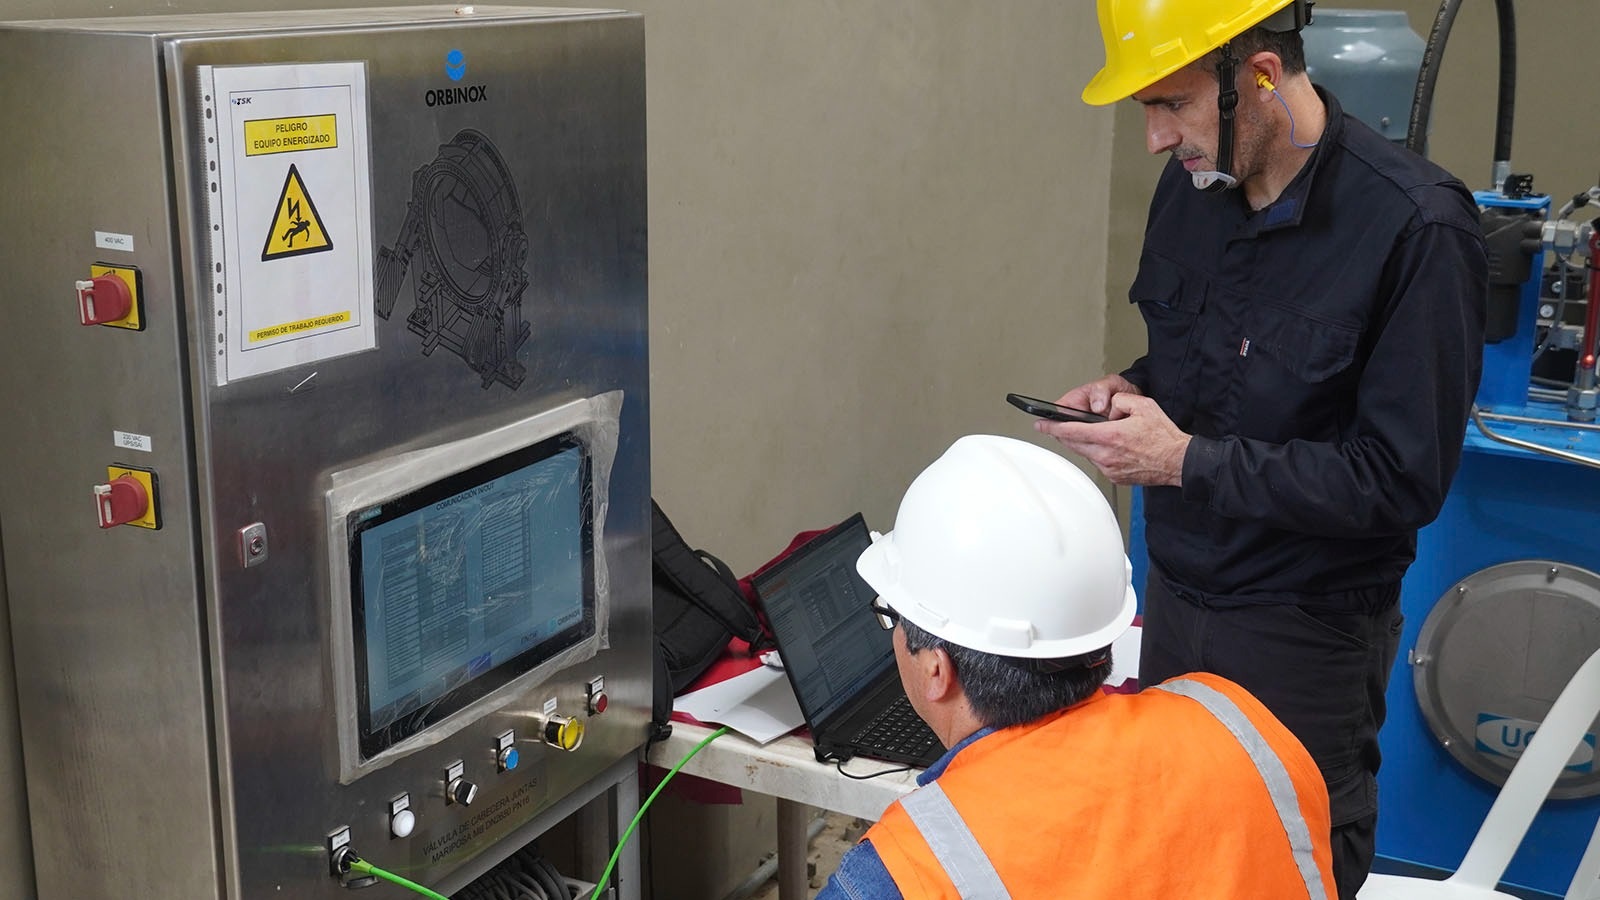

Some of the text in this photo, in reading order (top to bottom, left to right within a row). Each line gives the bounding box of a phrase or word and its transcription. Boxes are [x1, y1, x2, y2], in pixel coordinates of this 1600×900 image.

[236, 97, 252, 106] TSK
[425, 85, 488, 107] ORBINOX
[275, 122, 308, 133] PELIGRO
[254, 134, 330, 149] EQUIPO ENERGIZADO
[256, 314, 344, 339] PERMISO DE TRABAJO REQUERIDO
[459, 820, 470, 834] DE
